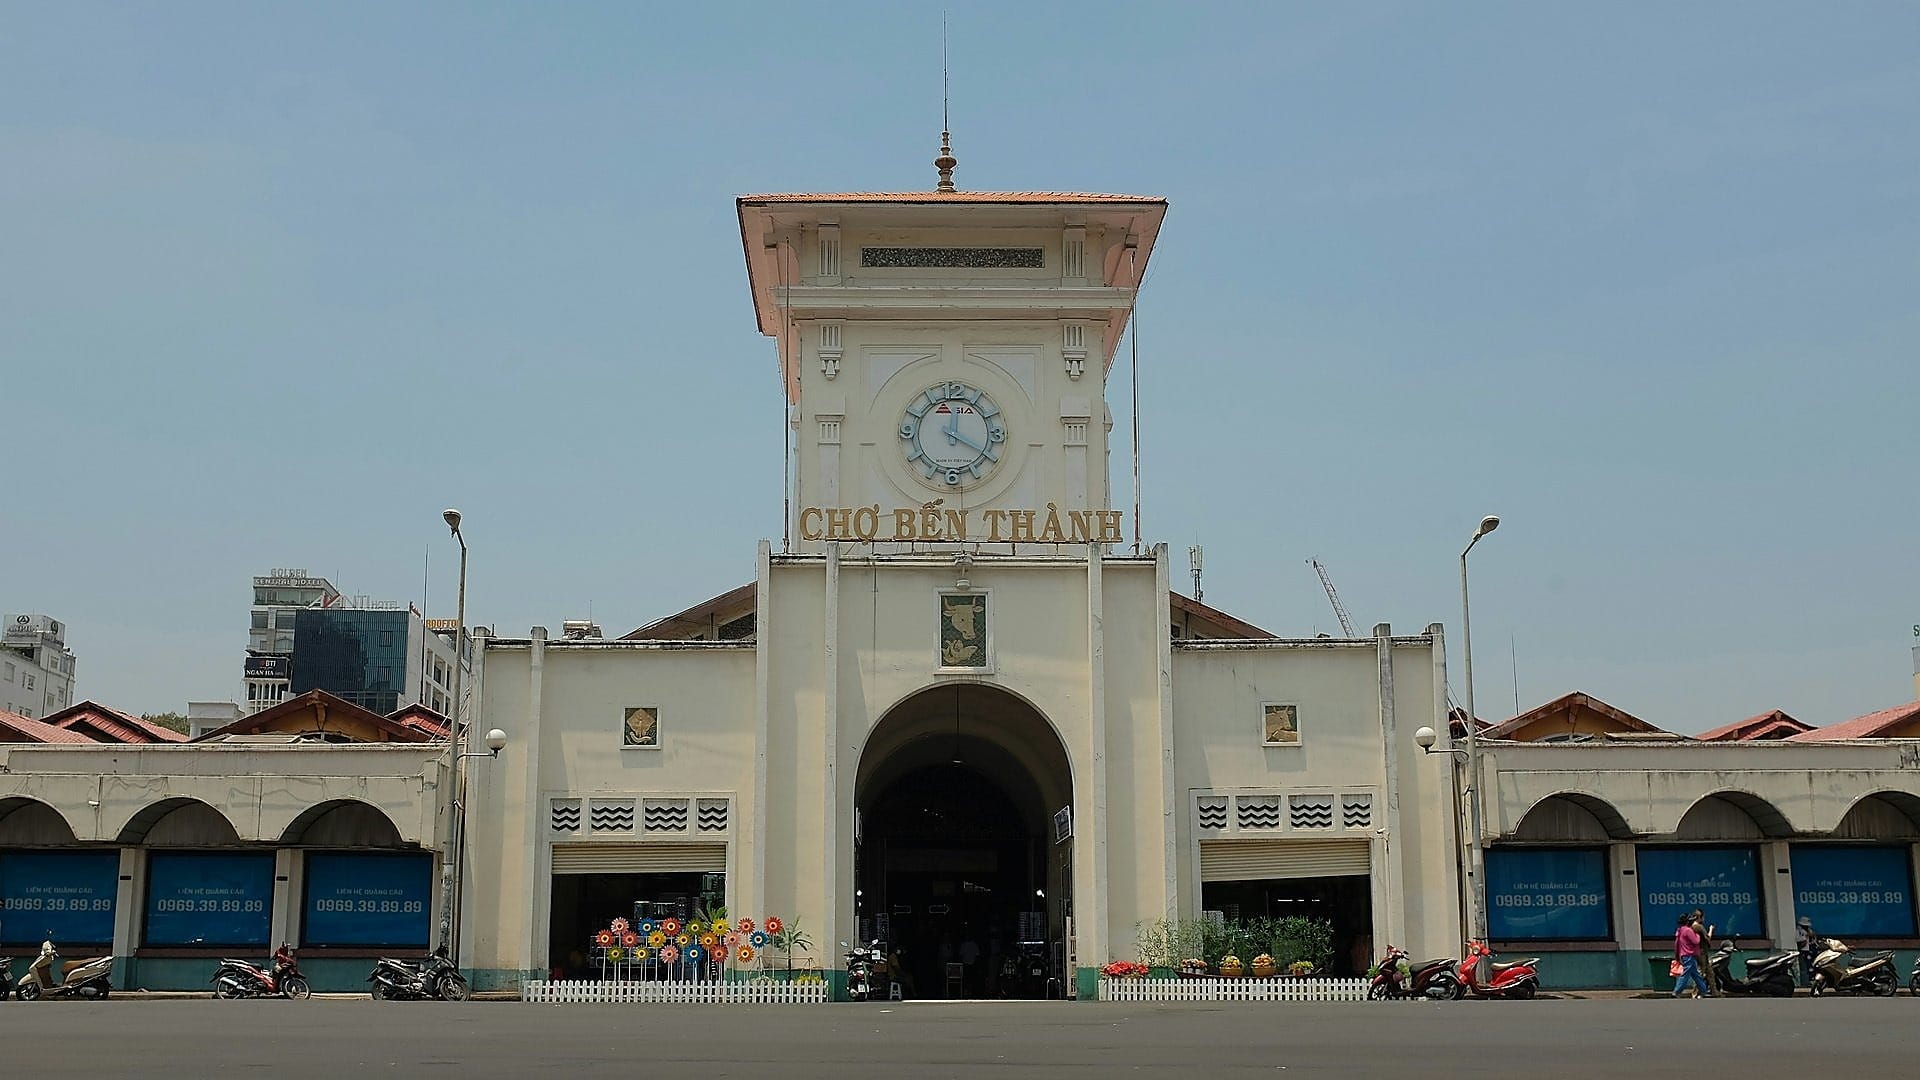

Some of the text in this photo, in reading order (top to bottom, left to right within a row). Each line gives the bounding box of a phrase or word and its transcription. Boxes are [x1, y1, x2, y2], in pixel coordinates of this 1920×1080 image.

[942, 383, 966, 399] 12
[900, 424, 915, 439] 9
[990, 426, 1005, 443] 3
[944, 468, 961, 485] 6
[800, 498, 1123, 545] CHỢ BẾN THÀNH
[270, 568, 307, 578] GOLDEN
[1495, 894, 1598, 907] 0969.39.89.89
[1649, 892, 1751, 905] 0969.39.89.89
[1800, 891, 1903, 904] 0969.39.89.89
[5, 898, 111, 911] 0969.39.89.89
[158, 899, 263, 912] 0969.39.89.89
[317, 899, 422, 913] 0969.39.89.89
